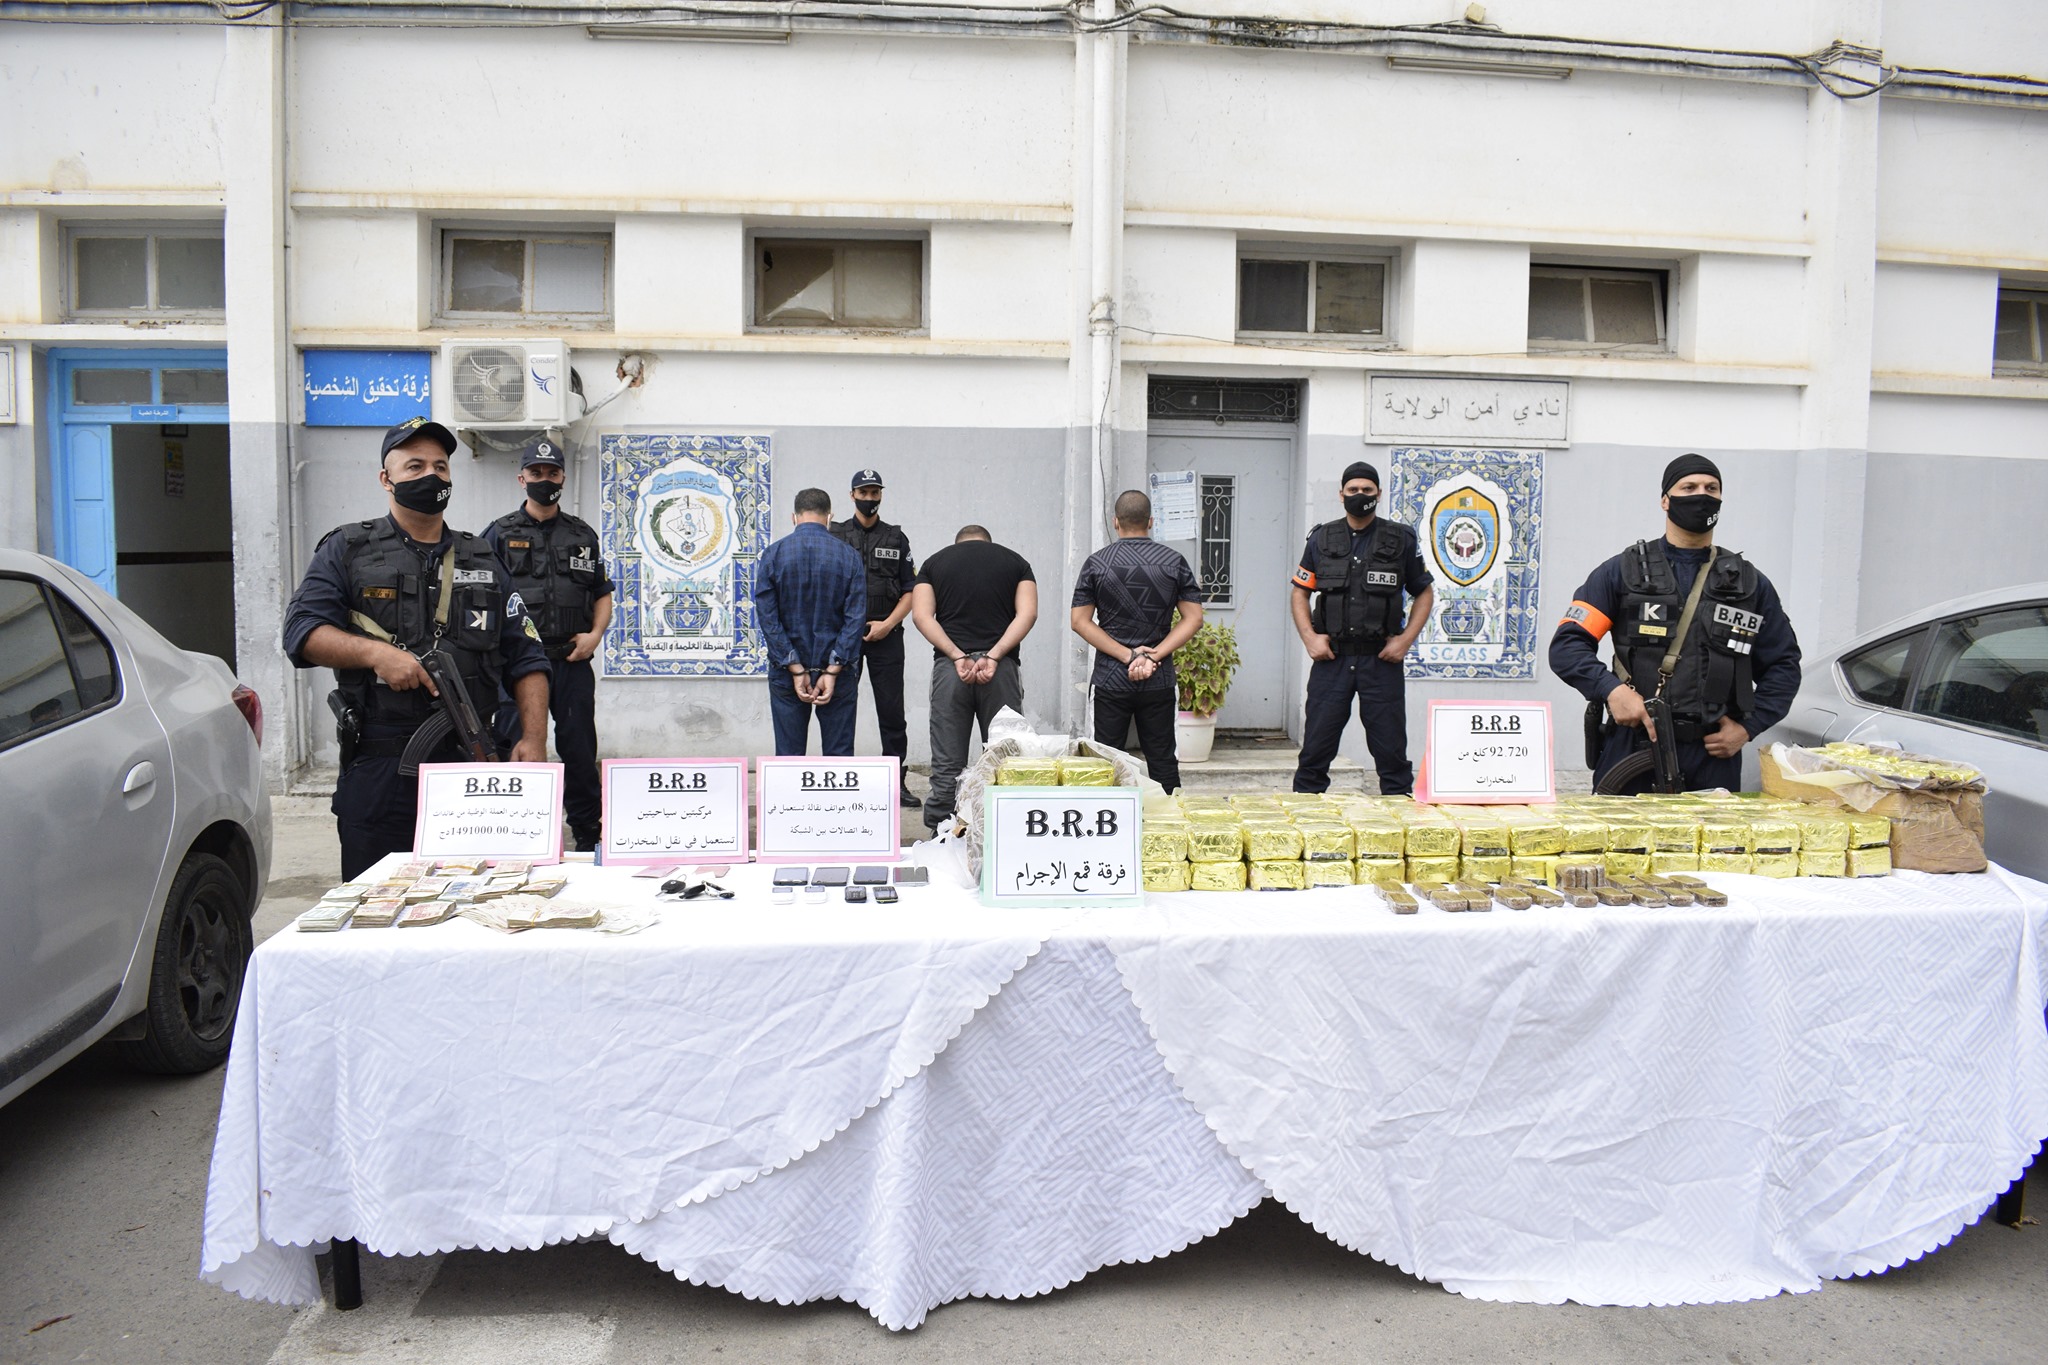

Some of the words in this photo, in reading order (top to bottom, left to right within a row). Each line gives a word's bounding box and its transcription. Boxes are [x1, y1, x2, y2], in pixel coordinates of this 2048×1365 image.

[304, 373, 359, 401] الشخصية
[363, 376, 399, 403] تحقيق
[402, 374, 429, 402] فرقة
[1384, 392, 1450, 420] الولاية
[1464, 393, 1499, 420] أمن
[1513, 398, 1560, 425] نادي
[877, 549, 898, 558] B.R.B
[455, 571, 489, 582] .R.B
[1369, 573, 1396, 584] B.R.B
[1644, 602, 1661, 621] K
[1718, 607, 1758, 630] B.R.B
[703, 640, 731, 652] الشرطة
[1430, 646, 1487, 661] SCASS
[1471, 714, 1521, 732] B.R.B
[1458, 752, 1469, 761] من
[465, 777, 523, 793] B.R.B
[648, 772, 707, 790] B.R.B
[801, 771, 859, 789] B.R.B
[1476, 774, 1517, 787] المخدرات
[637, 808, 677, 820] سياحيتين
[680, 805, 712, 820] مركبتين
[767, 803, 777, 815] في
[779, 804, 805, 814] تستعمل
[790, 824, 813, 834] الشبكة
[861, 825, 874, 836] ربط
[1025, 809, 1119, 839] B.R.B
[615, 835, 661, 849] المخدرات
[665, 835, 681, 849] نقل
[684, 835, 697, 849] في
[700, 835, 735, 849] تستعمل
[1015, 861, 1067, 890] الإجرام
[1073, 860, 1091, 892] قمع
[1097, 862, 1126, 885] فرقة
